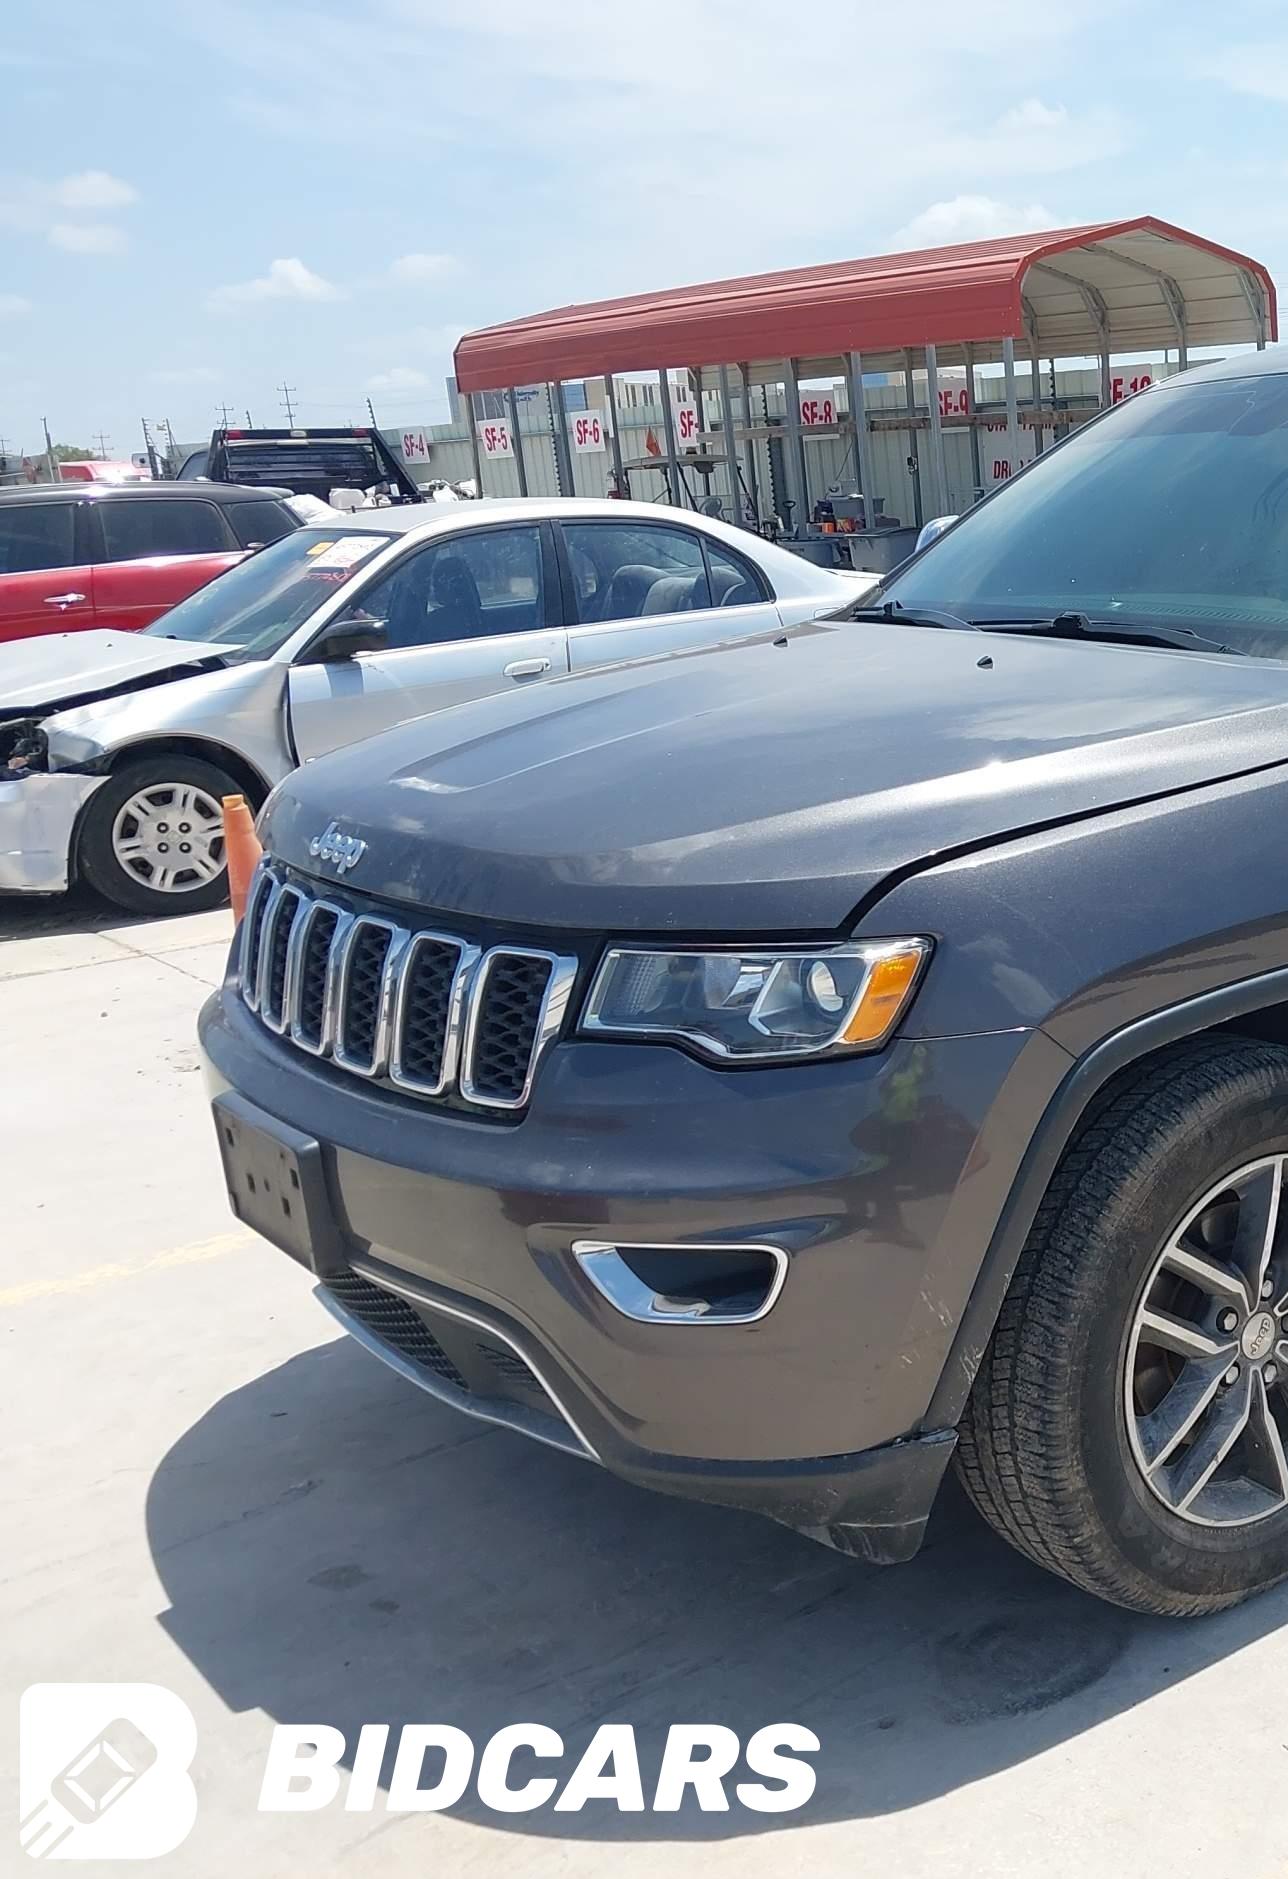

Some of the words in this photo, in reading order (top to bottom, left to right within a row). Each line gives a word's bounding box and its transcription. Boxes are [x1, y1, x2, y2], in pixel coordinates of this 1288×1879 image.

[403, 433, 425, 457] SF-4
[484, 426, 508, 452] SF-5
[576, 418, 600, 445] SF-6
[309, 821, 368, 874] Jeep
[1250, 1317, 1271, 1355] Jeep
